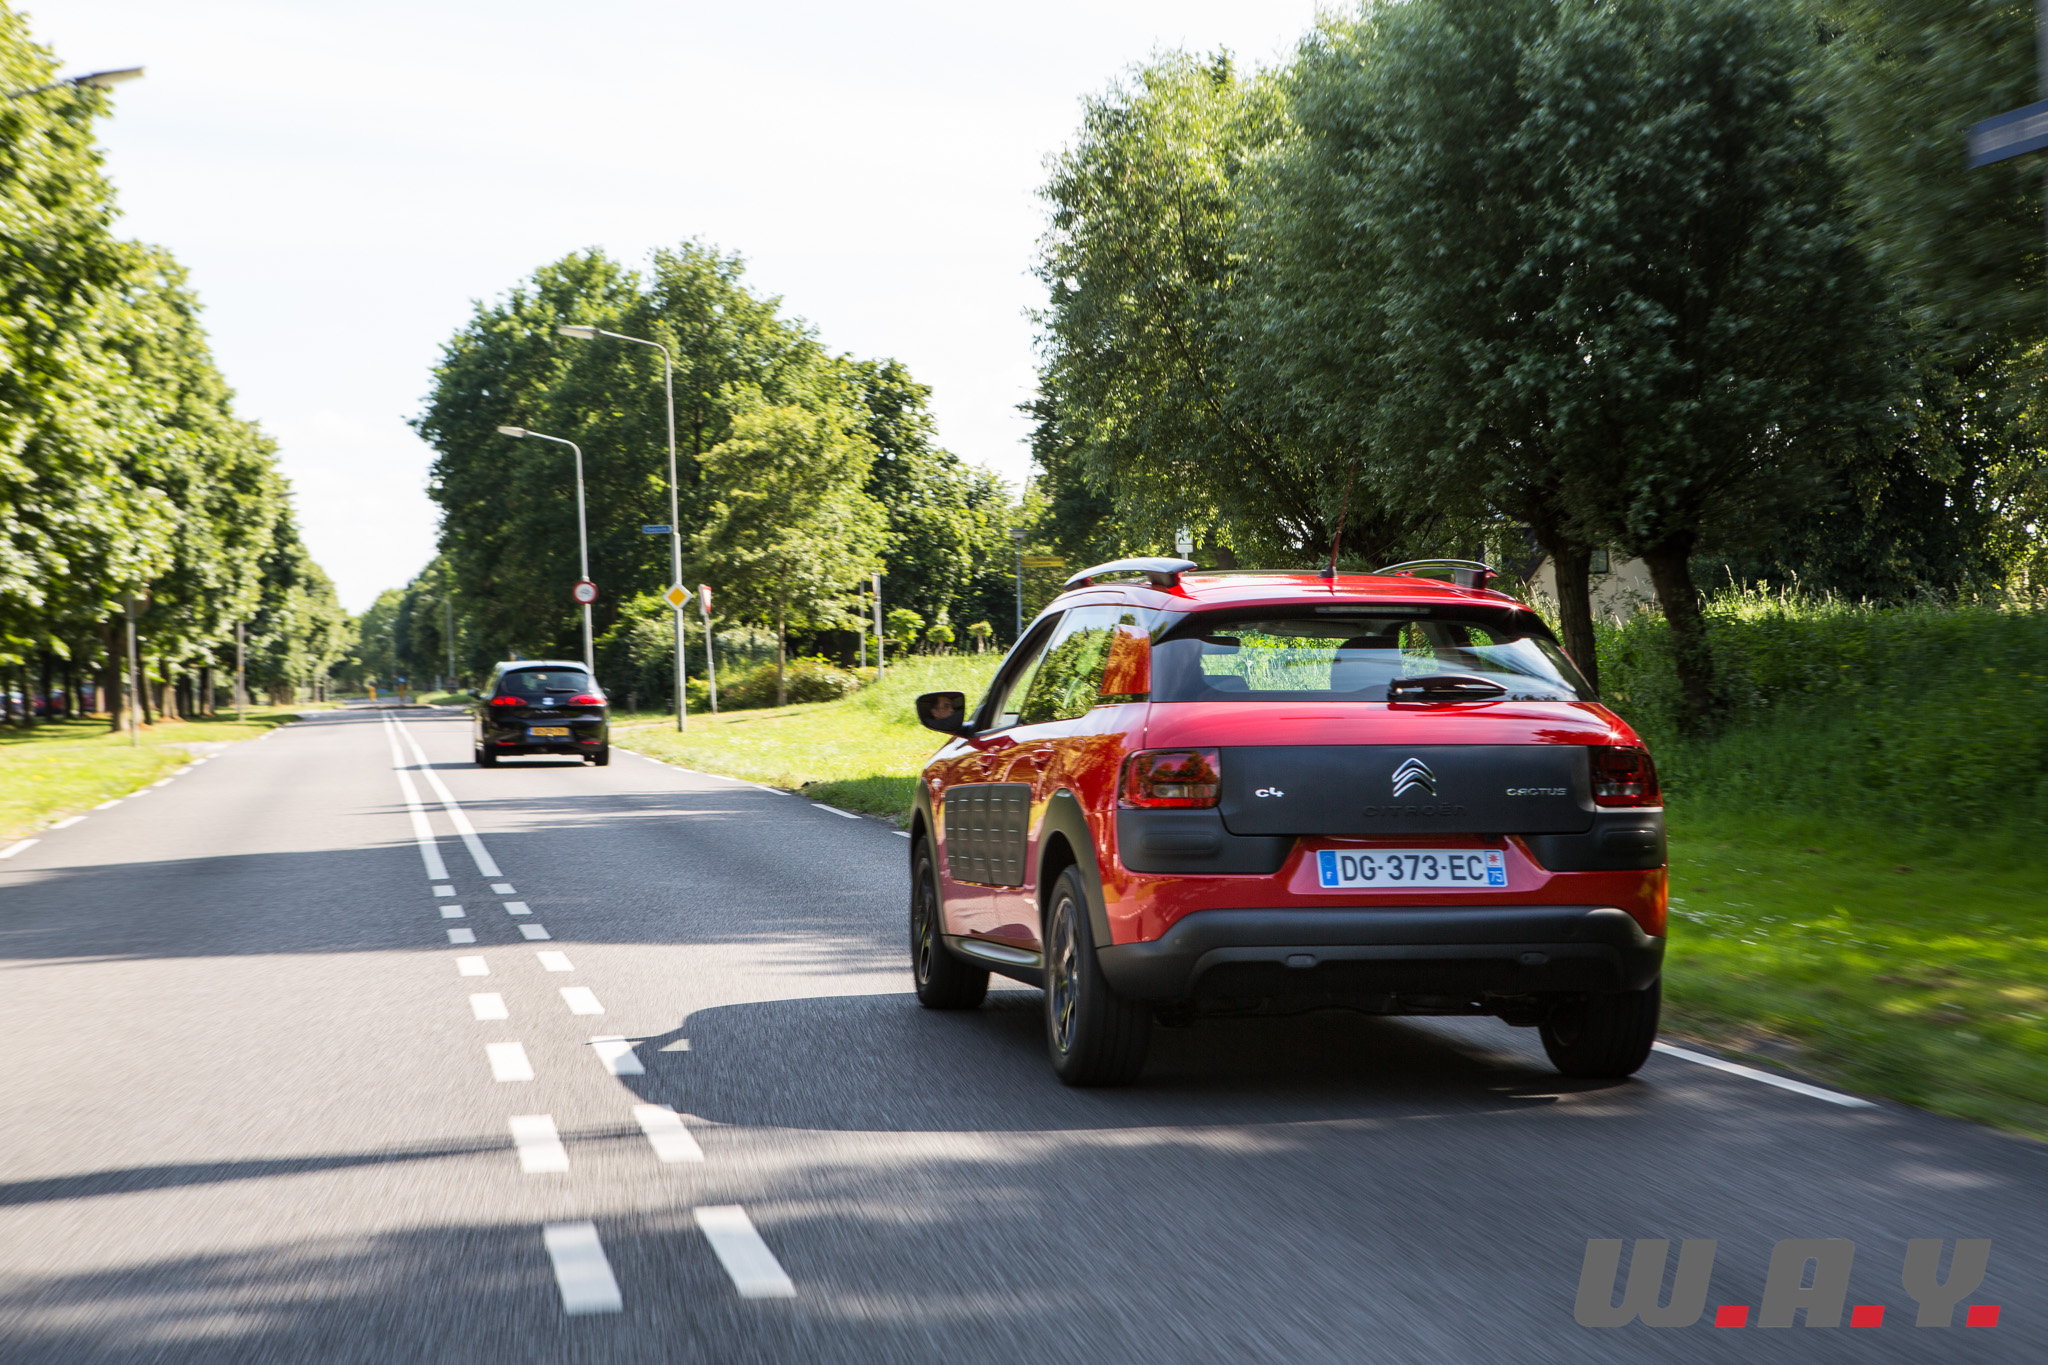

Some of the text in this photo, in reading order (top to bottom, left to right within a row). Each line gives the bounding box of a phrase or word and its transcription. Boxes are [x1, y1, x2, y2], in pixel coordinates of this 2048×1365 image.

[1506, 787, 1567, 796] CACTUS
[1340, 855, 1484, 881] DG-373-EC
[1325, 871, 1333, 880] F
[1489, 870, 1504, 882] 75
